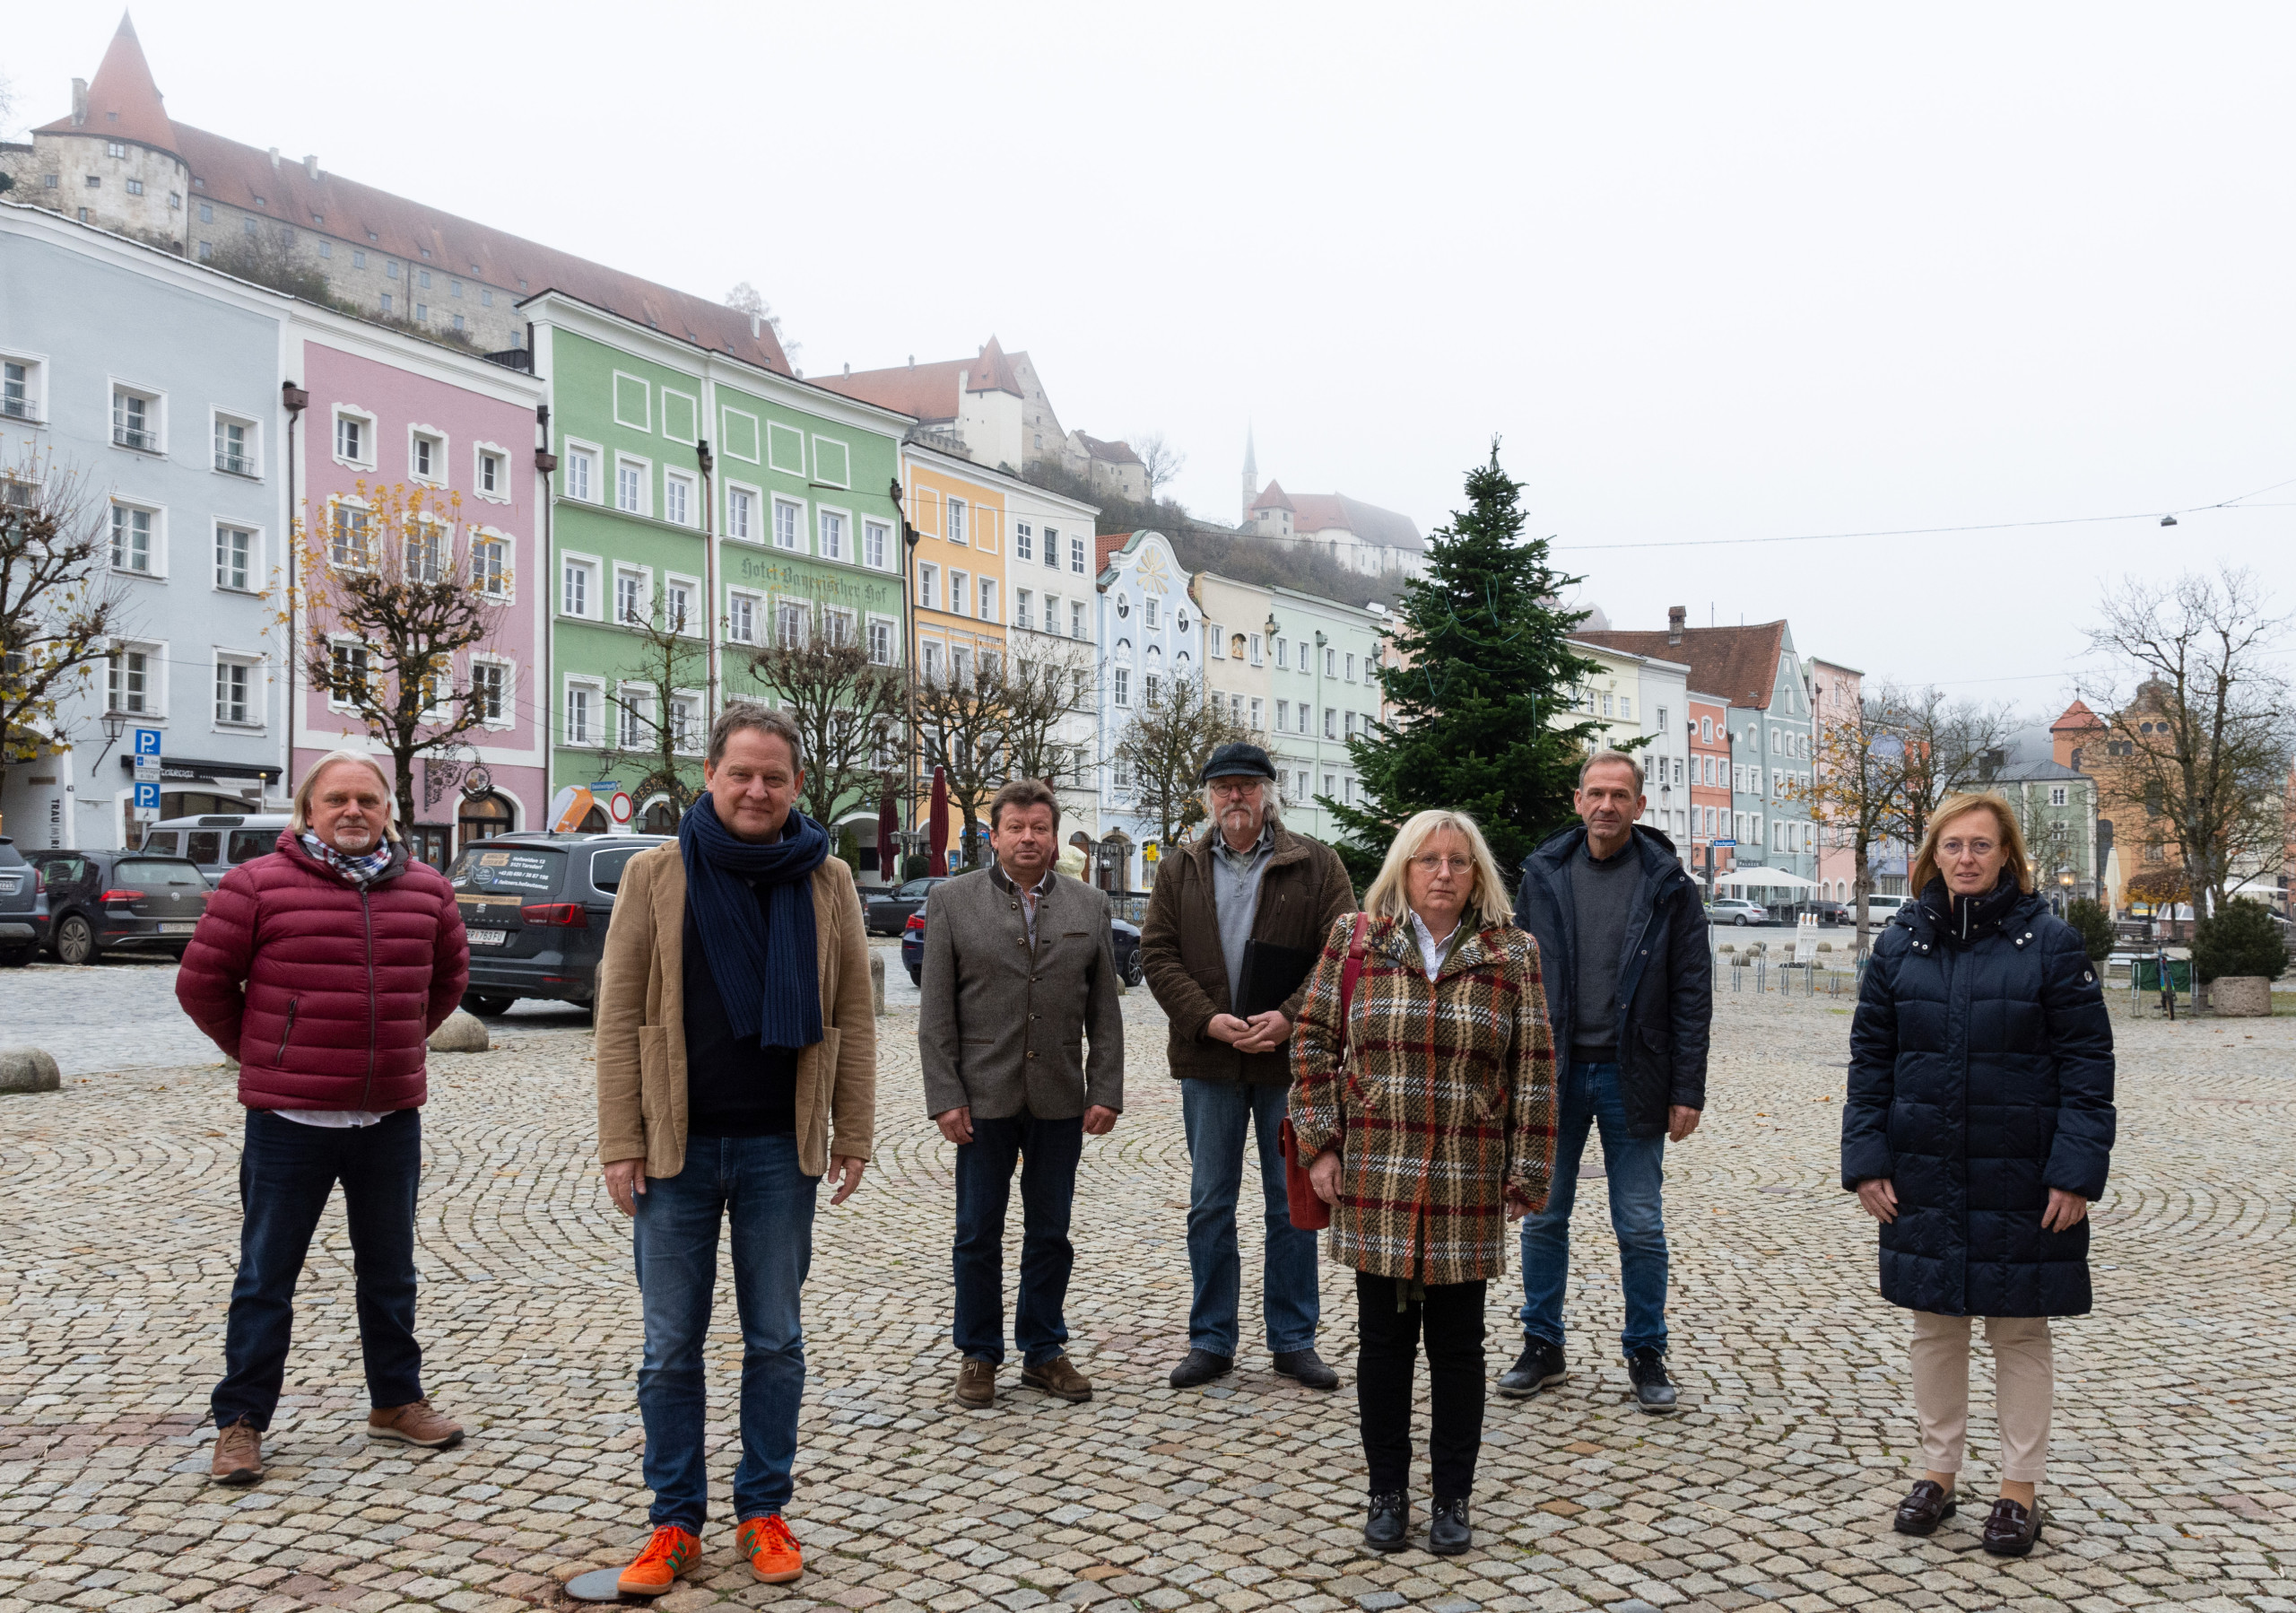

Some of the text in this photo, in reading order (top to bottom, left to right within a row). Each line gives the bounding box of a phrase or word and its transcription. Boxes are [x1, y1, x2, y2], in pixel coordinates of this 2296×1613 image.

[741, 558, 887, 604] Hotel Bayerischer Hof
[141, 732, 155, 753] P
[140, 786, 154, 806] P
[49, 798, 60, 849] TRAU(M)RI
[479, 930, 492, 940] 763
[493, 932, 503, 941] FU
